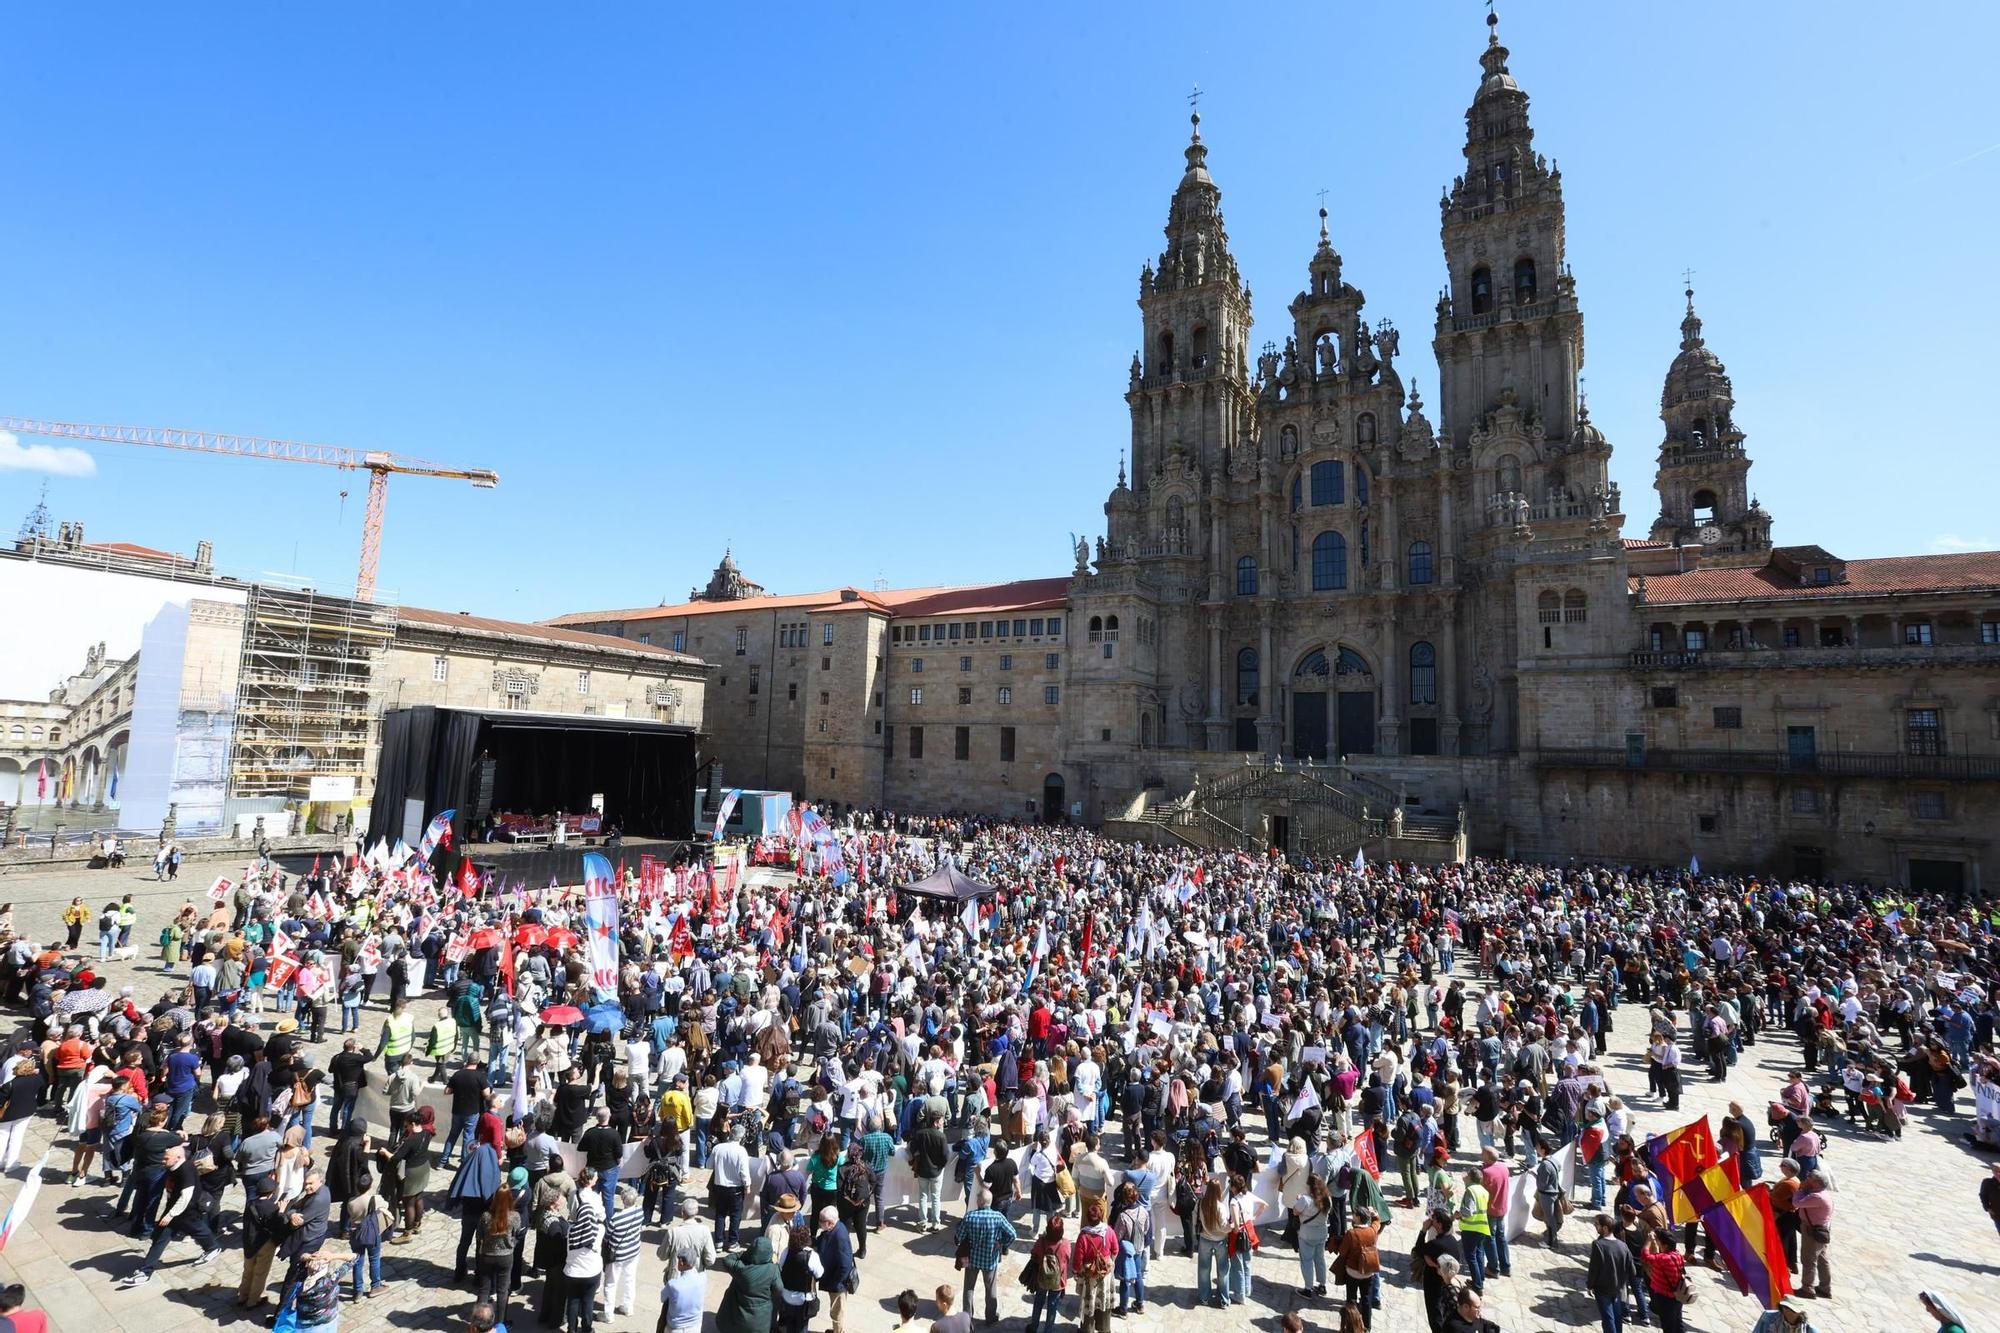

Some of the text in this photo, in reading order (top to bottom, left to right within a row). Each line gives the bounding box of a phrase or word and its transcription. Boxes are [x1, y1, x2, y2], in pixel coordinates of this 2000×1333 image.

[809, 819, 826, 832] CIG
[831, 859, 848, 872] CIG
[586, 877, 616, 897] CIG
